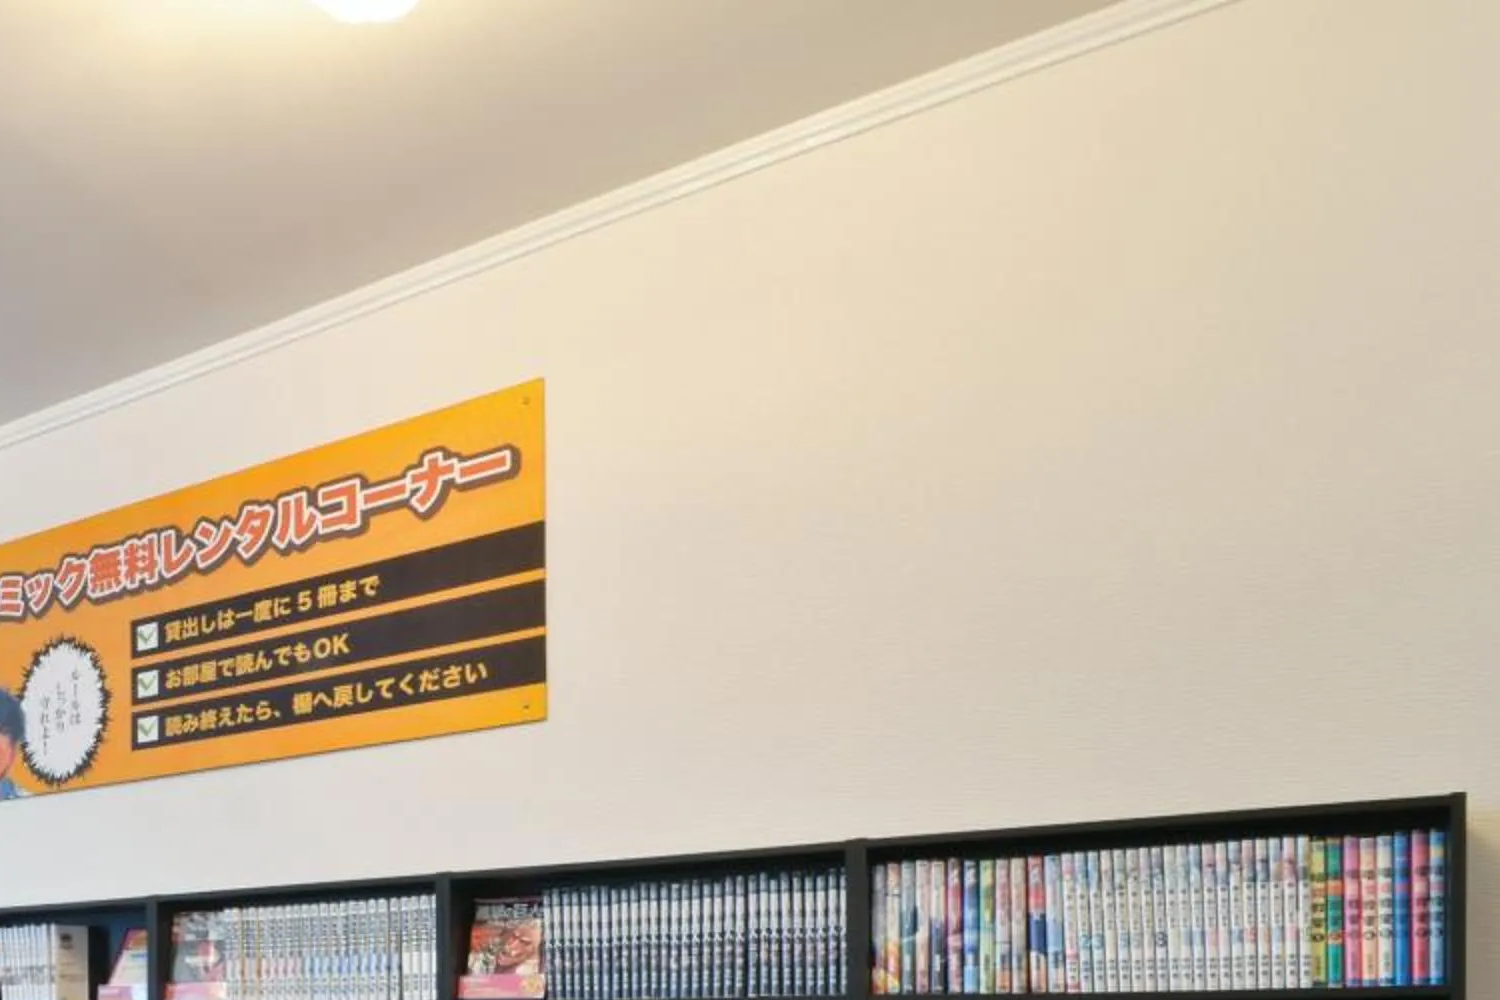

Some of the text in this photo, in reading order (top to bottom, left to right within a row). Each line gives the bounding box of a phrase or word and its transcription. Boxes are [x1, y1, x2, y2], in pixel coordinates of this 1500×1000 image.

[164, 633, 350, 690] お部屋で読んでもOK
[164, 662, 489, 738] 読み終えたら、棚へ戻してください
